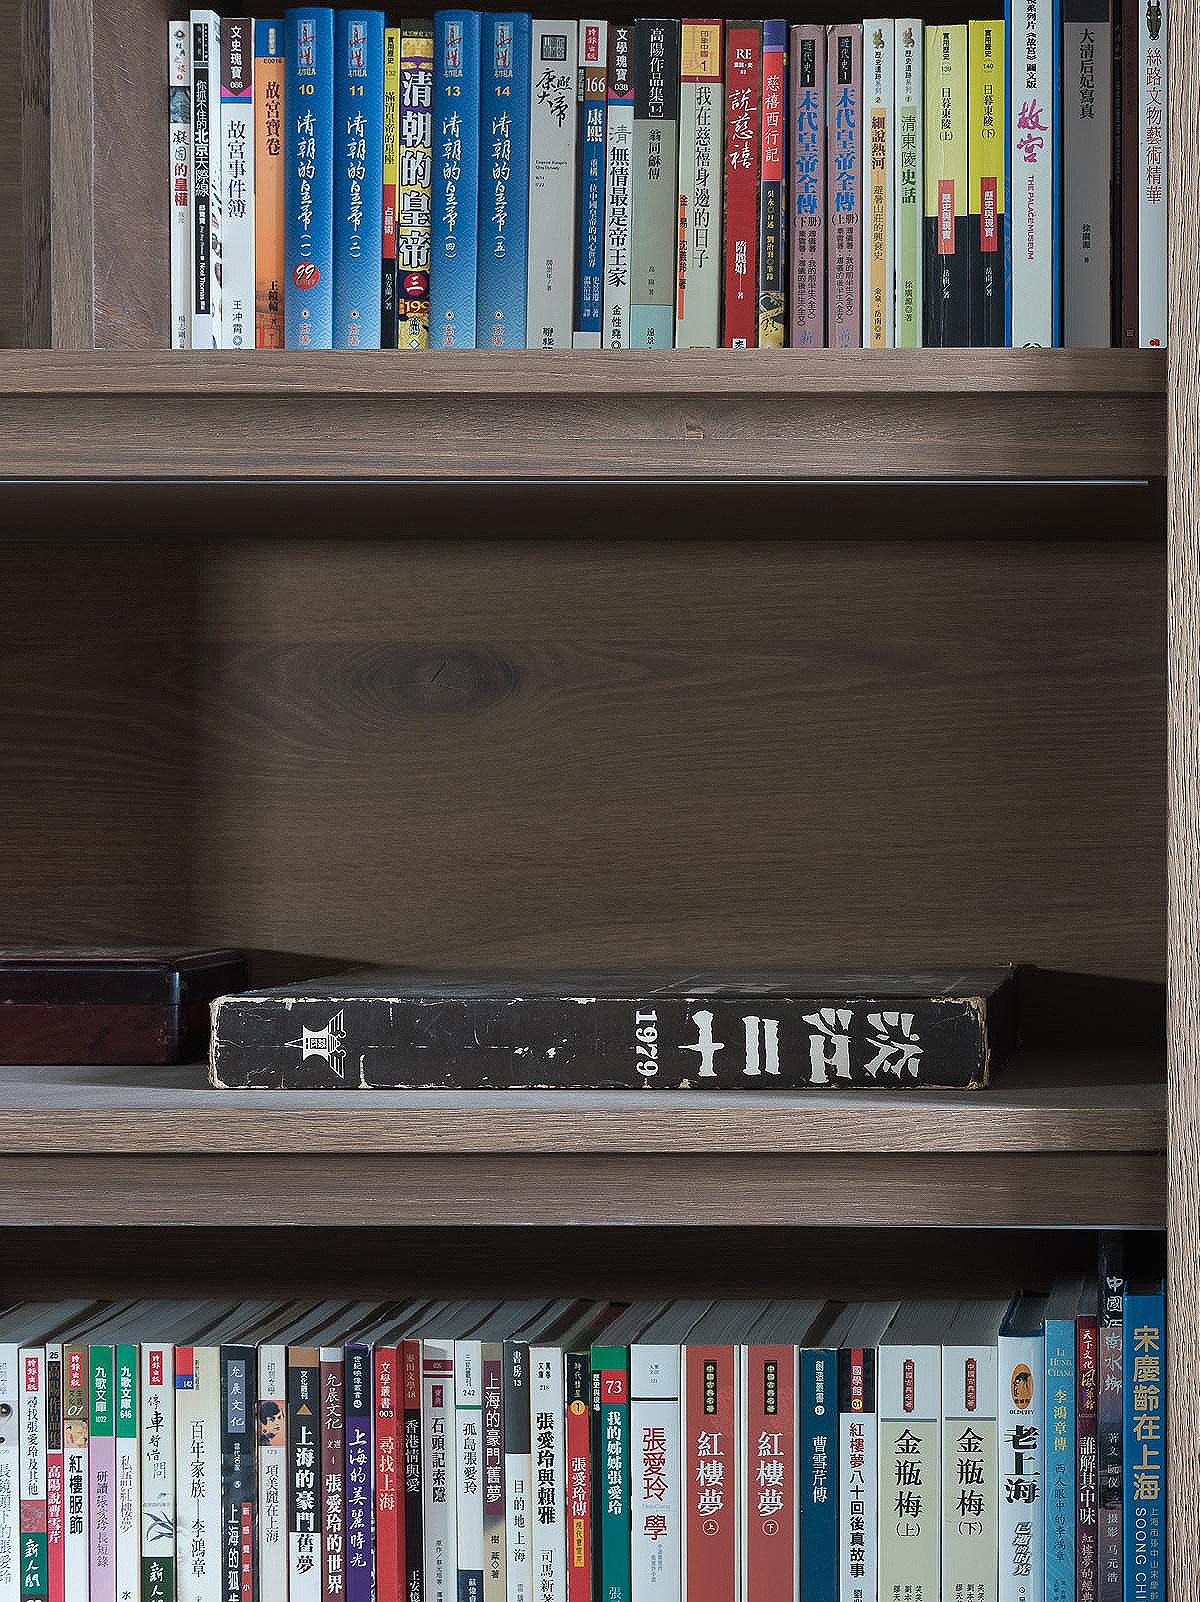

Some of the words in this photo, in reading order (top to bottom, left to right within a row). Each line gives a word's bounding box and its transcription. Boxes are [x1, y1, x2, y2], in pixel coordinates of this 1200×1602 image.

[230, 25, 242, 80] 文史瑰寶
[586, 77, 605, 92] 166
[616, 28, 628, 82] 文學瑰寶
[736, 48, 752, 60] RE
[1080, 28, 1096, 119] 大清后妃寫真
[265, 81, 281, 156] 故宮寶卷
[299, 84, 314, 96] 10
[349, 84, 364, 96] 11
[445, 86, 461, 97] 13
[495, 86, 511, 97] 14
[587, 108, 603, 143] 康熙
[764, 75, 782, 163] 慈禧西行記
[1146, 48, 1162, 204] 絲路文物藝術精華
[729, 88, 757, 170] 說慈禧
[795, 90, 820, 214] 末代皇帝全傳
[834, 87, 857, 212] 末代皇帝全傳
[871, 116, 886, 170] 細說熱河
[901, 115, 917, 204] 清東陵史話
[1016, 98, 1049, 163] 故宮
[227, 120, 247, 218] 故宮事件簿
[400, 71, 433, 268] 清朝的皇帝
[693, 86, 713, 269] 我在慈禧身邊的日子
[1027, 175, 1035, 190] THE
[1027, 192, 1035, 223] PALACE
[1027, 224, 1035, 260] MUSEUM
[406, 276, 425, 293] 三
[635, 1010, 659, 1077] 1979
[49, 1351, 59, 1360] 25
[513, 1351, 522, 1377] 書房
[513, 1379, 522, 1387] 13
[1082, 1329, 1094, 1370] 天下文化
[68, 1406, 83, 1416] 01
[95, 1366, 107, 1413] 九歌文庫
[120, 1366, 132, 1409] 九歌文庫
[231, 1366, 245, 1427] 允晨文化
[325, 1373, 343, 1430] 允晨文化
[462, 1389, 475, 1397] 242
[605, 1380, 622, 1394] 73
[1133, 1325, 1161, 1501] 宋慶齡在上海
[379, 1436, 396, 1511] 尋找上海
[405, 1420, 420, 1492] 香港情與愛
[431, 1417, 446, 1503] 石頭記索隱
[463, 1423, 478, 1495] 孤島張愛玲
[484, 1371, 501, 1504] 上海的豪門舊夢
[536, 1412, 555, 1524] 張愛玲與賴雅
[606, 1411, 623, 1516] 我的姊姊張愛玲
[812, 1435, 828, 1504] 曹雪芹傳
[1003, 1424, 1041, 1504] 老上海
[48, 1465, 62, 1545] 高陽說曹雪芹
[69, 1455, 83, 1534] 紅樓服飾
[266, 1464, 280, 1543] 項美麗在上海
[295, 1425, 315, 1575] 上海的豪門舊夢
[349, 1428, 368, 1567] 上海的美麗時光
[571, 1457, 587, 1517] 張愛玲傳
[696, 1431, 724, 1517] 紅樓夢
[756, 1431, 784, 1517] 紅樓夢
[850, 1422, 865, 1577] 紅樓夢八十回後真故事
[894, 1428, 923, 1537] 金瓶梅（上）
[956, 1427, 985, 1536] 金瓶梅（下）
[1080, 1436, 1096, 1526] 誰解其中味
[325, 1473, 343, 1594] 張愛玲的世界
[513, 1479, 526, 1562] 目的地上海
[1135, 1507, 1147, 1565] SOONG
[150, 1563, 165, 1602] 新人
